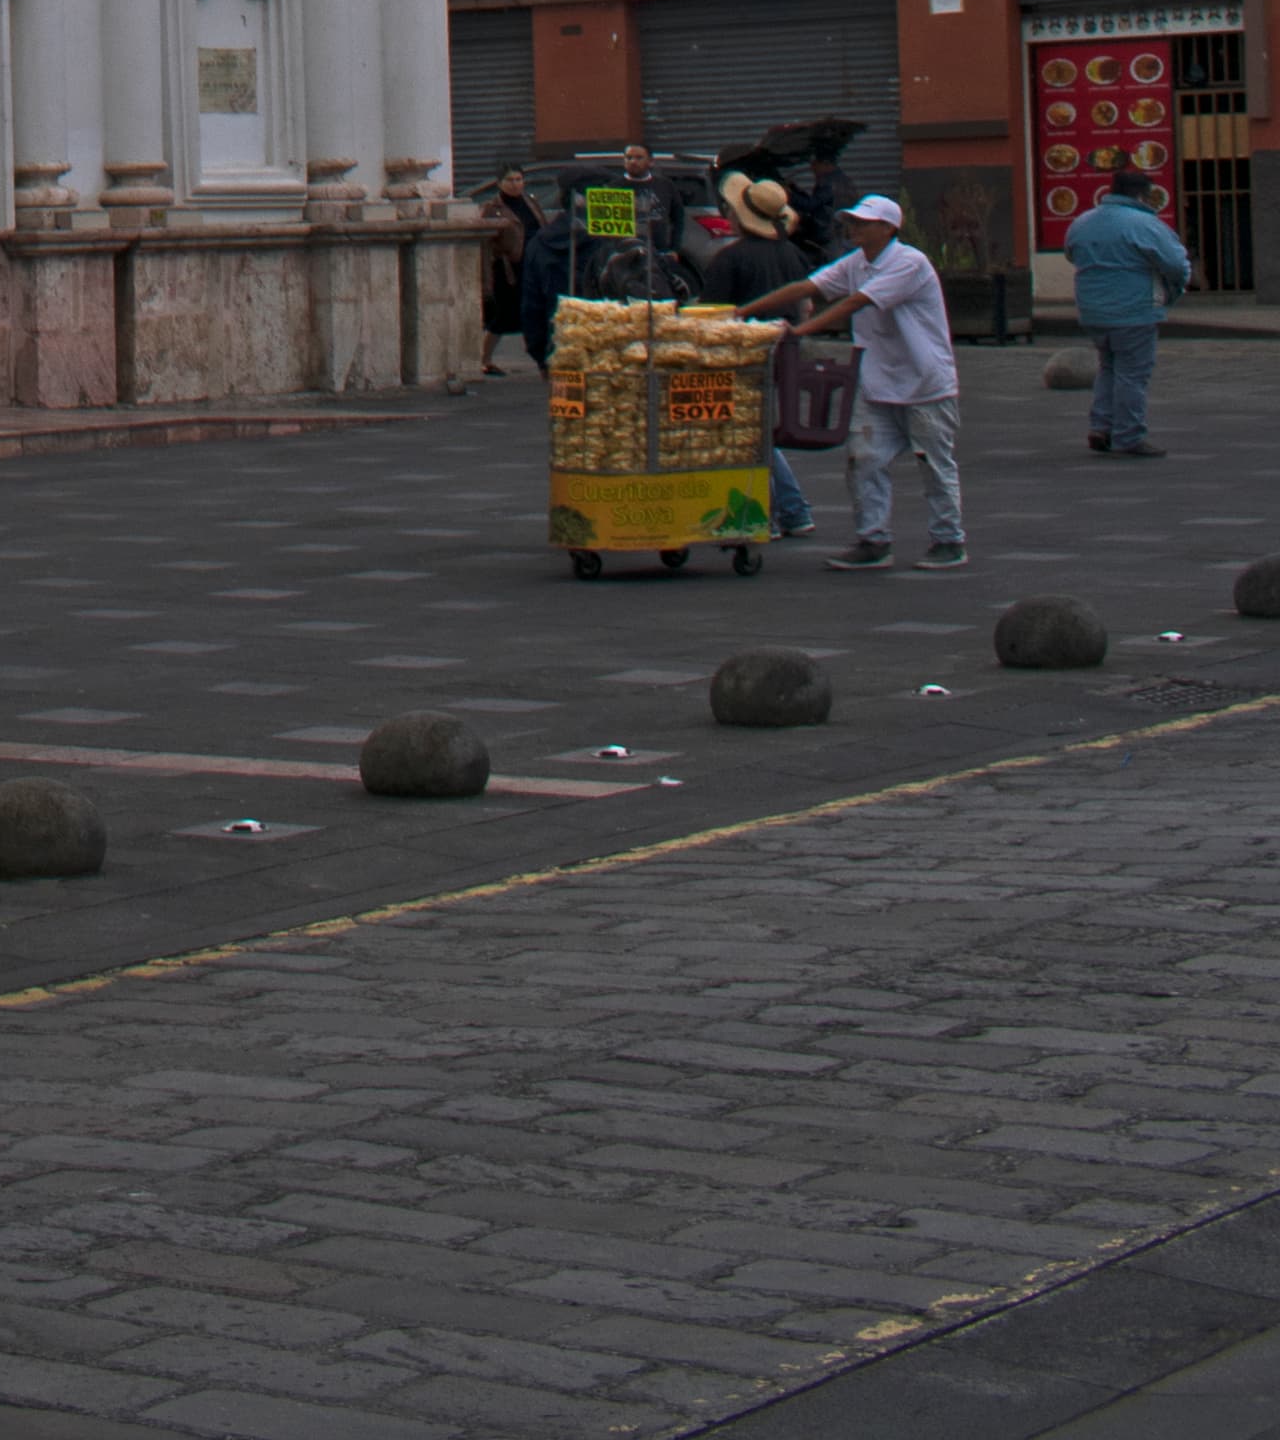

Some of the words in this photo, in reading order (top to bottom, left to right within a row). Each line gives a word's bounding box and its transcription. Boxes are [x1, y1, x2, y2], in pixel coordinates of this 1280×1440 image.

[591, 221, 634, 235] SOYA
[671, 373, 733, 389] CUERITOS
[694, 390, 713, 403] DE
[551, 405, 582, 417] OYA
[671, 404, 732, 420] SOYA
[569, 479, 673, 502] Cueritos
[612, 503, 674, 531] Soya
